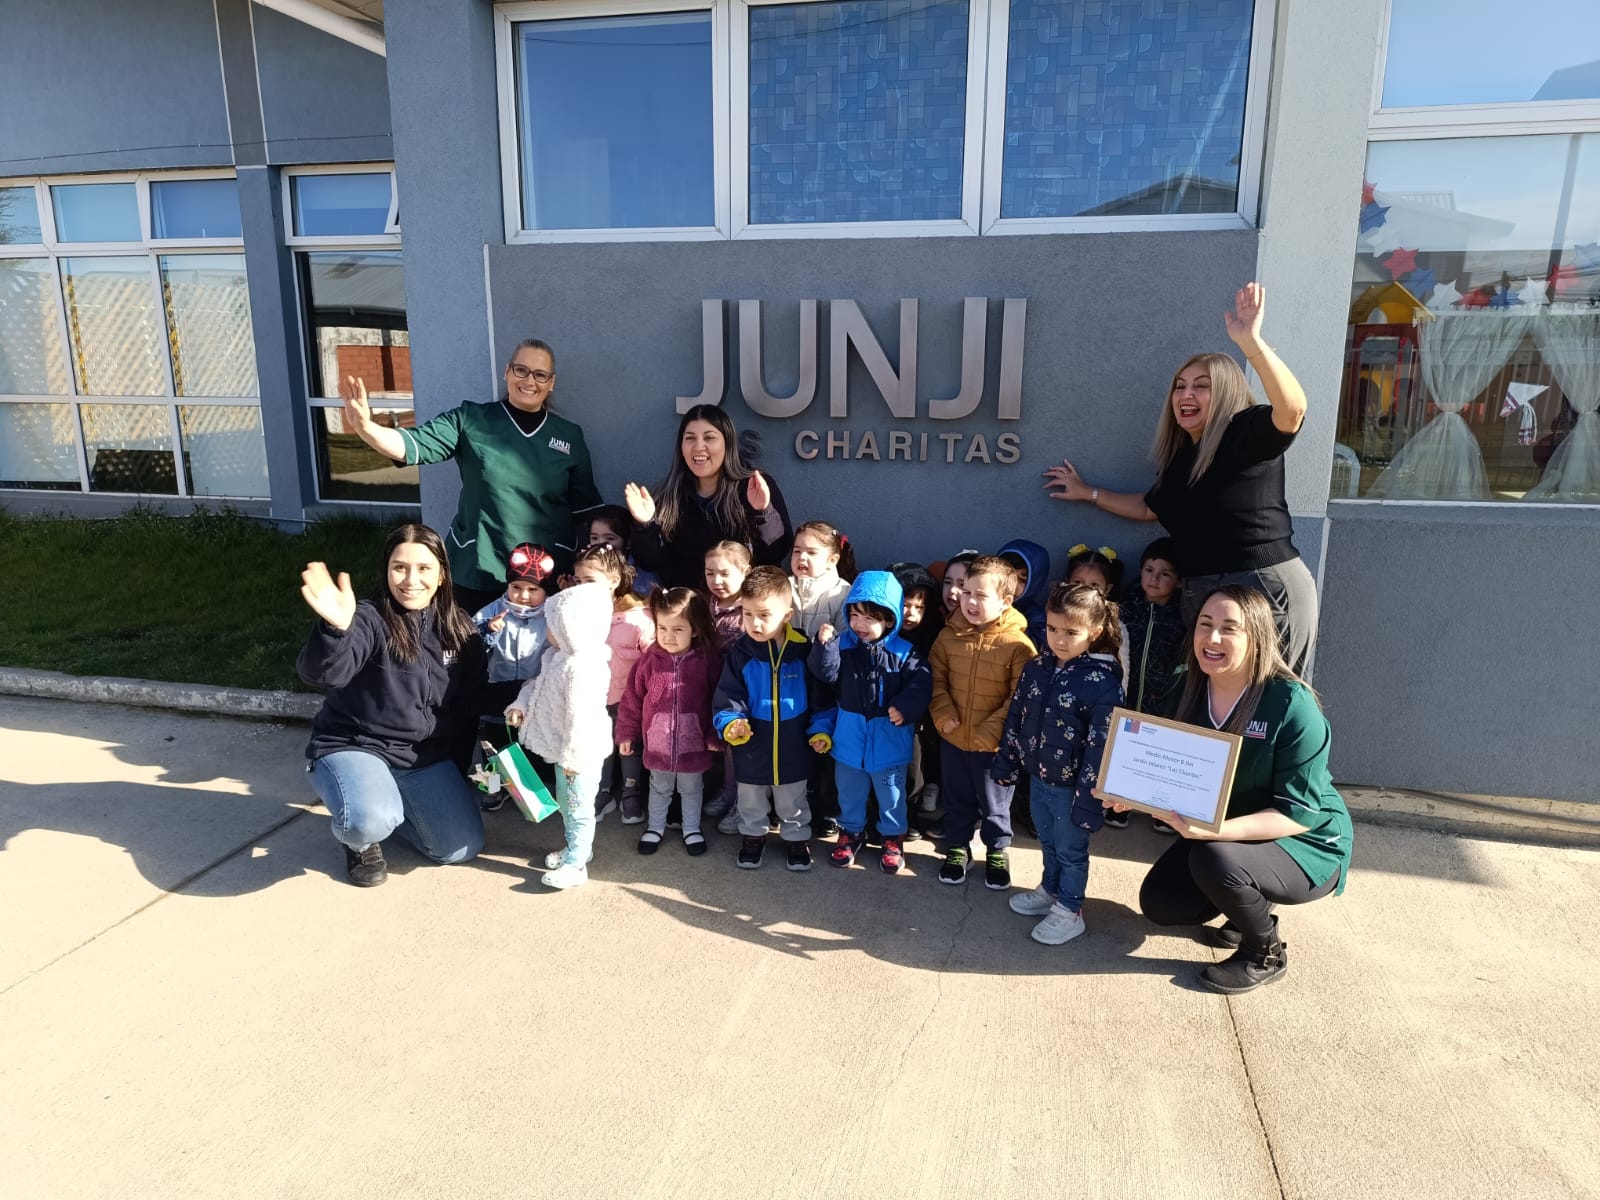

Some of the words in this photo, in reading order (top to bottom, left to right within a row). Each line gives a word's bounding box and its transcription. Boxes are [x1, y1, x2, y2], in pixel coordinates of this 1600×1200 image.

[675, 297, 1028, 420] JUNJI
[549, 437, 571, 451] JUNJI
[795, 430, 1022, 464] CHARITAS
